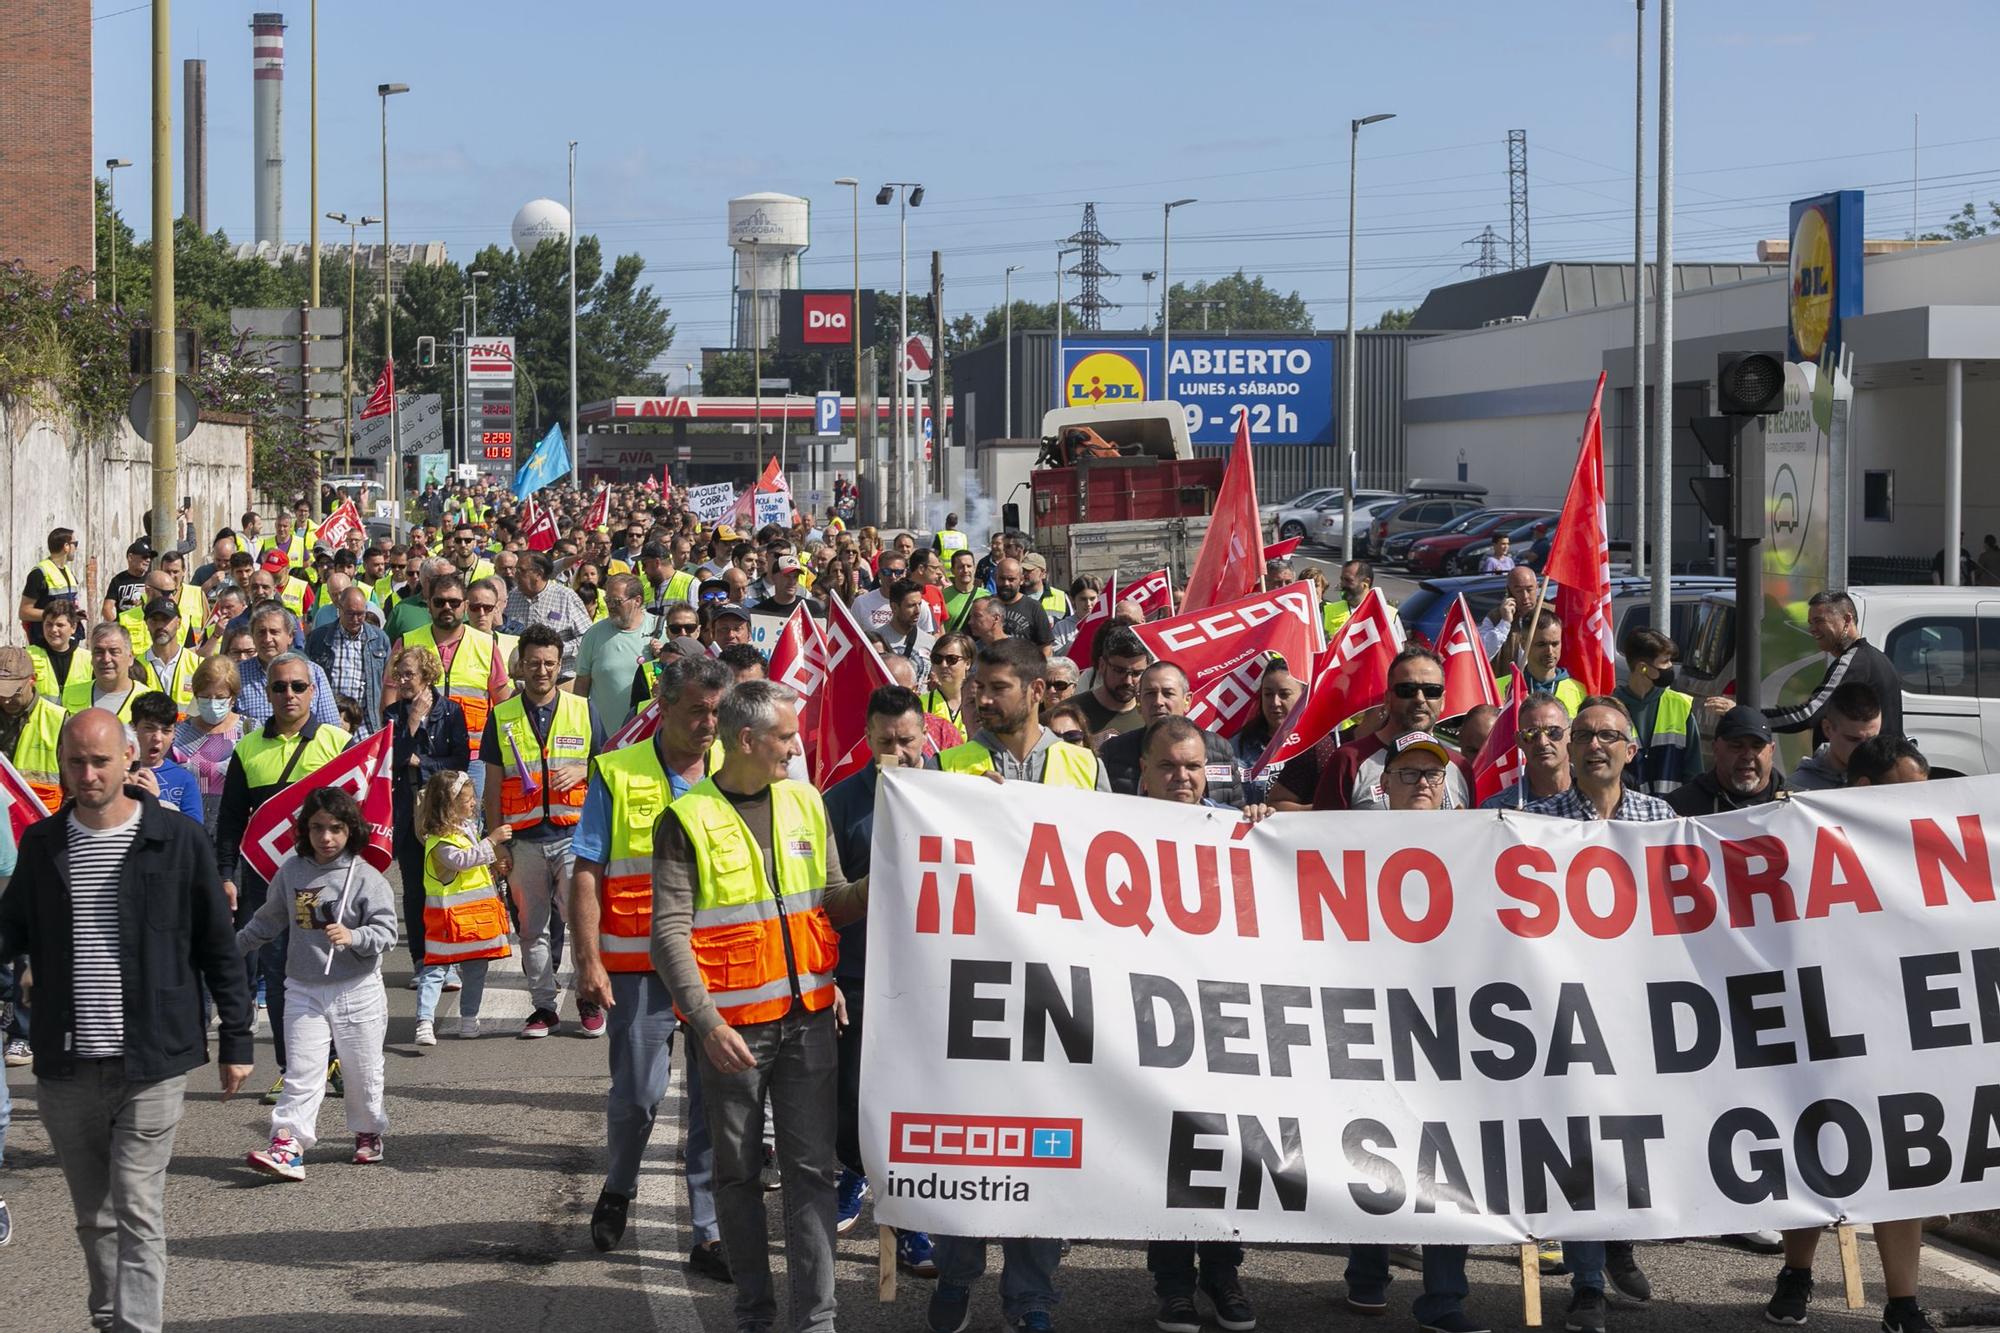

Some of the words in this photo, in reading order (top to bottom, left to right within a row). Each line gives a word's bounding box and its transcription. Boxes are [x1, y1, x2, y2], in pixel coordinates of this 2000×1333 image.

[1168, 349, 1311, 375] ABIERTO
[1179, 383, 1225, 396] LUNES
[1239, 379, 1300, 396] SÁBADO
[641, 396, 693, 417] AVIA
[822, 399, 837, 429] P
[483, 431, 512, 444] 2.299
[486, 446, 512, 458] 1.019
[700, 495, 728, 507] SOBRA
[1197, 648, 1256, 679] ASTURIAS
[1017, 821, 1259, 938] AQUÍ
[1296, 847, 1454, 944] NO
[1494, 825, 1884, 940] SOBRA
[947, 959, 1094, 1064] EN
[1129, 972, 1617, 1081] DEFENSA
[1646, 965, 1867, 1075] DEL
[902, 1123, 1026, 1157] CCOO
[1166, 1110, 1307, 1211] EN
[1341, 1114, 1666, 1216] SAINT
[887, 1170, 1030, 1202] industria
